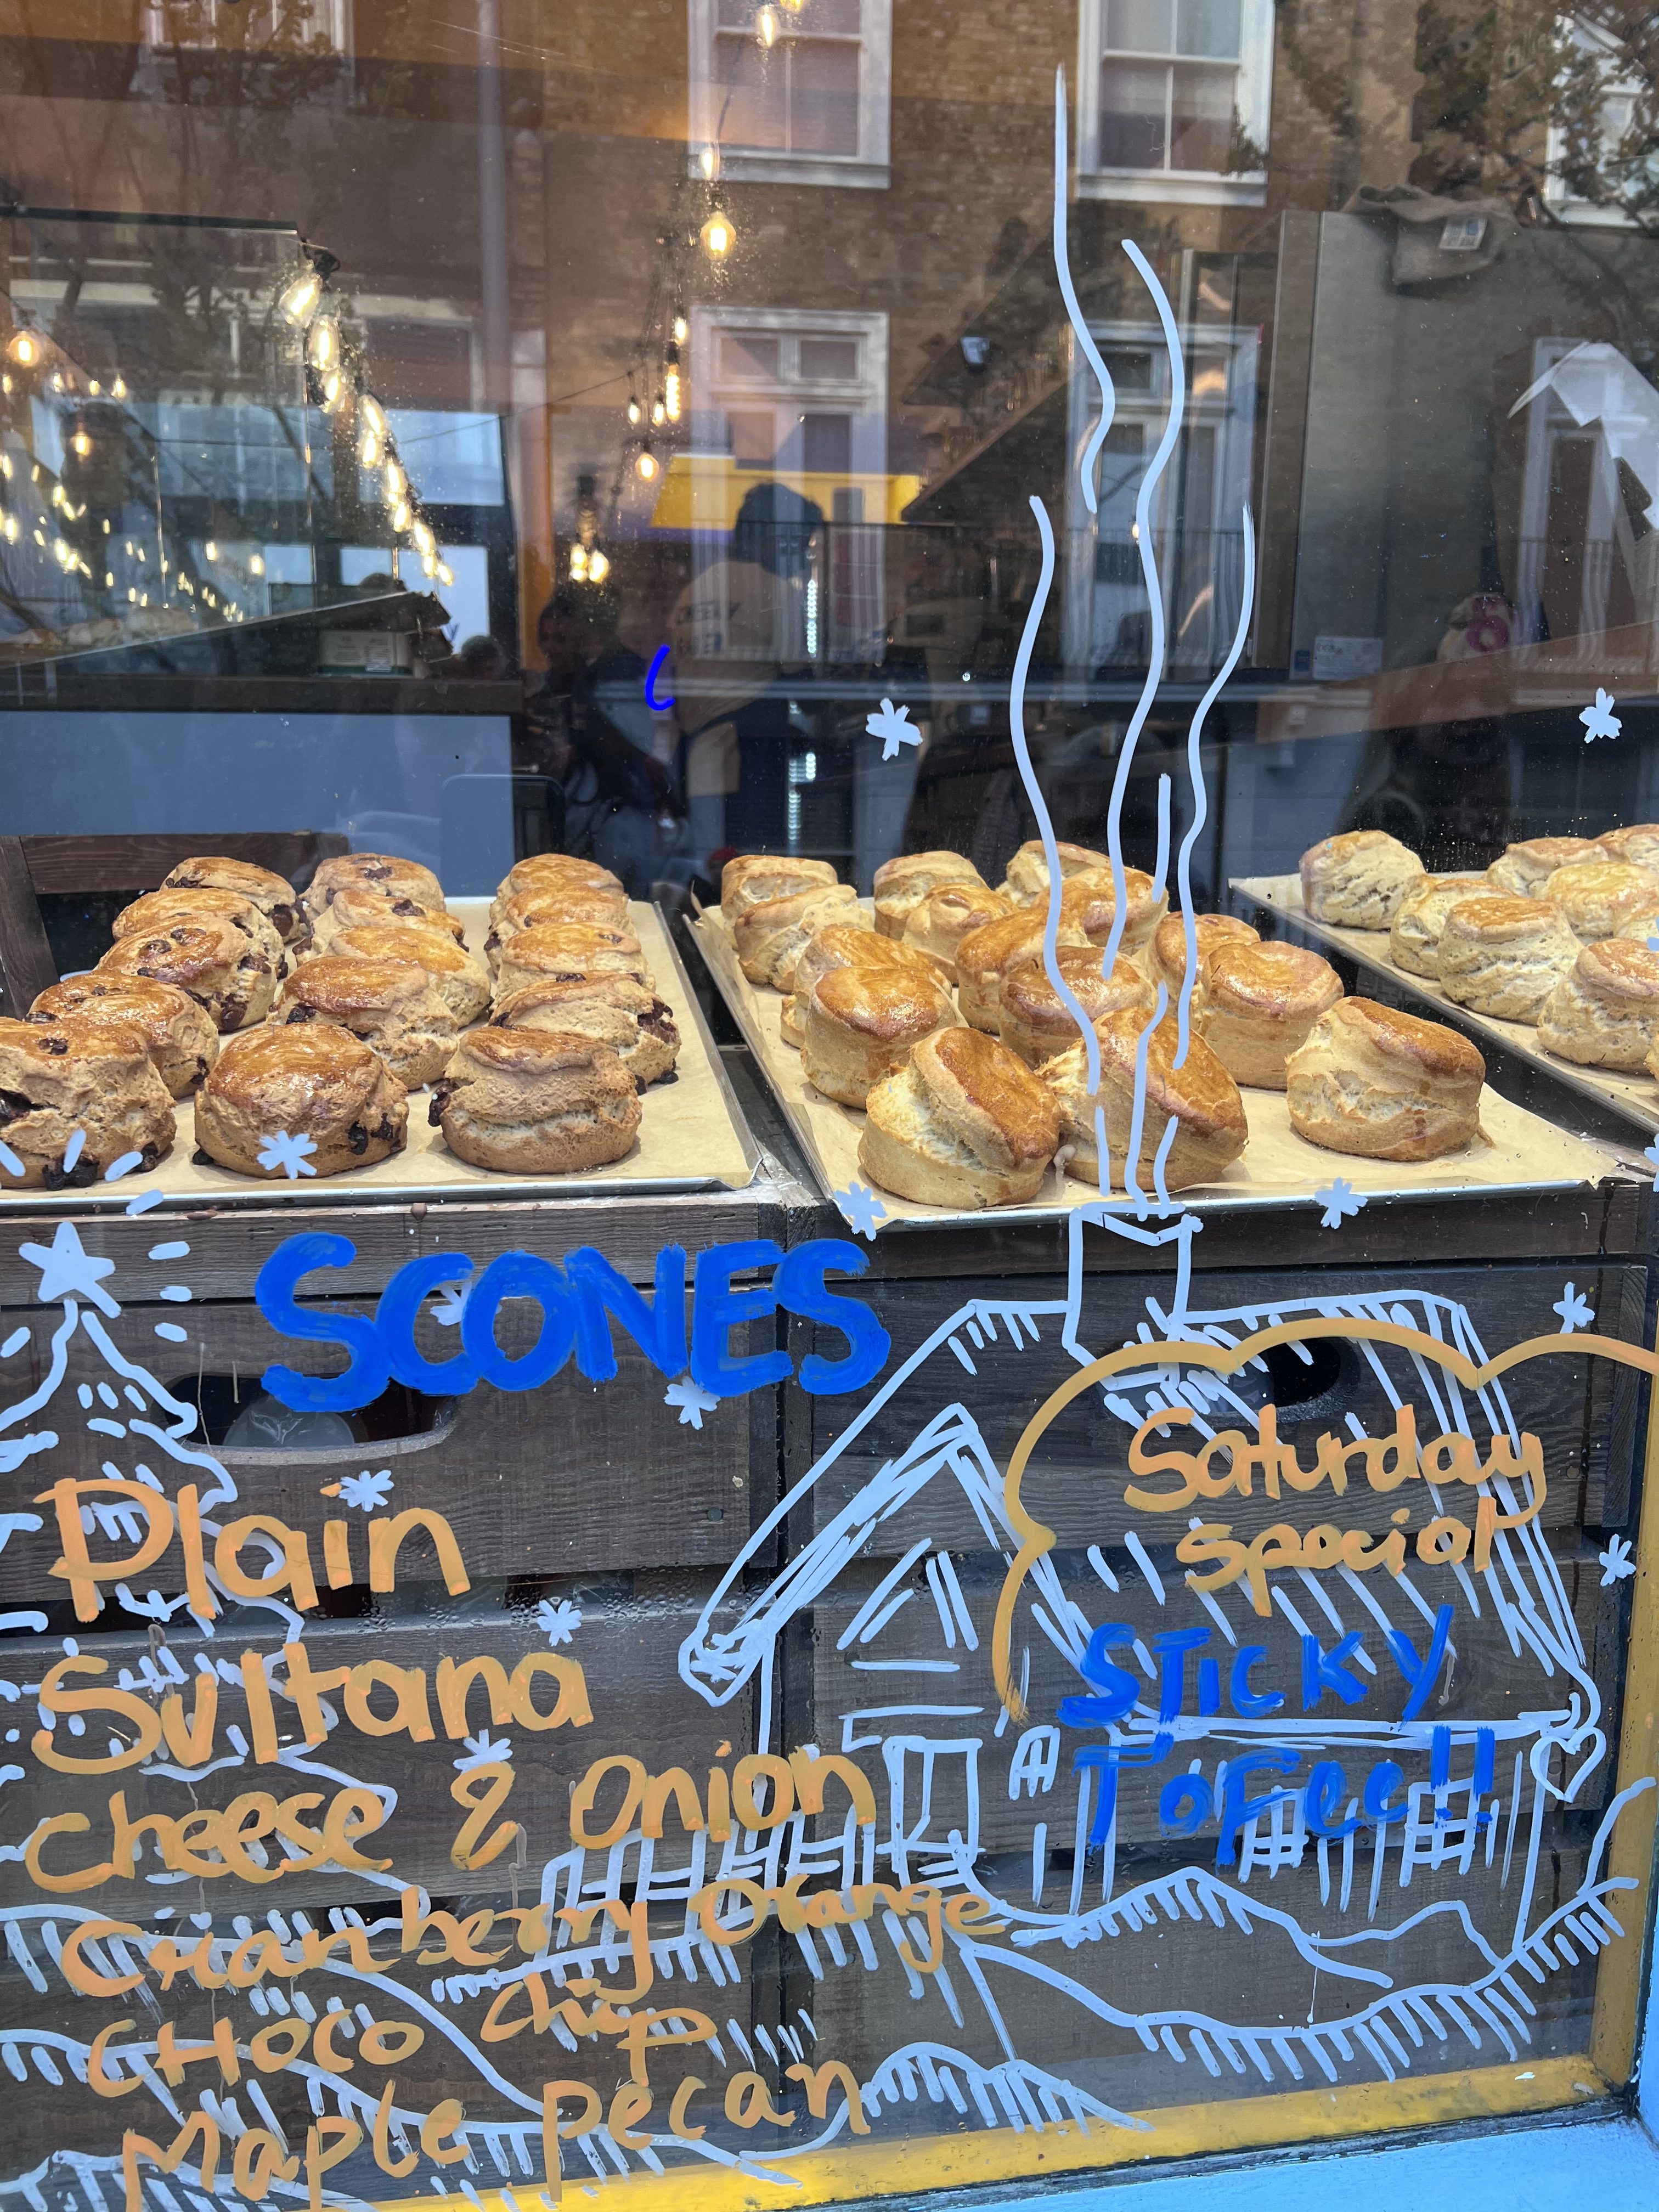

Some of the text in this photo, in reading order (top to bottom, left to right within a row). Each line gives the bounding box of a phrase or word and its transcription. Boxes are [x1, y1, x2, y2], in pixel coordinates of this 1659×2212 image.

[255, 1232, 891, 1412] SCONES
[1123, 1403, 1547, 1530] Saturday
[33, 1477, 471, 1623] Plain
[31, 1643, 594, 1774] Sultana
[451, 1761, 518, 1870] &
[570, 1740, 876, 1849] Onion
[689, 1874, 1006, 1973] Orange
[122, 2080, 469, 2212] Maple
